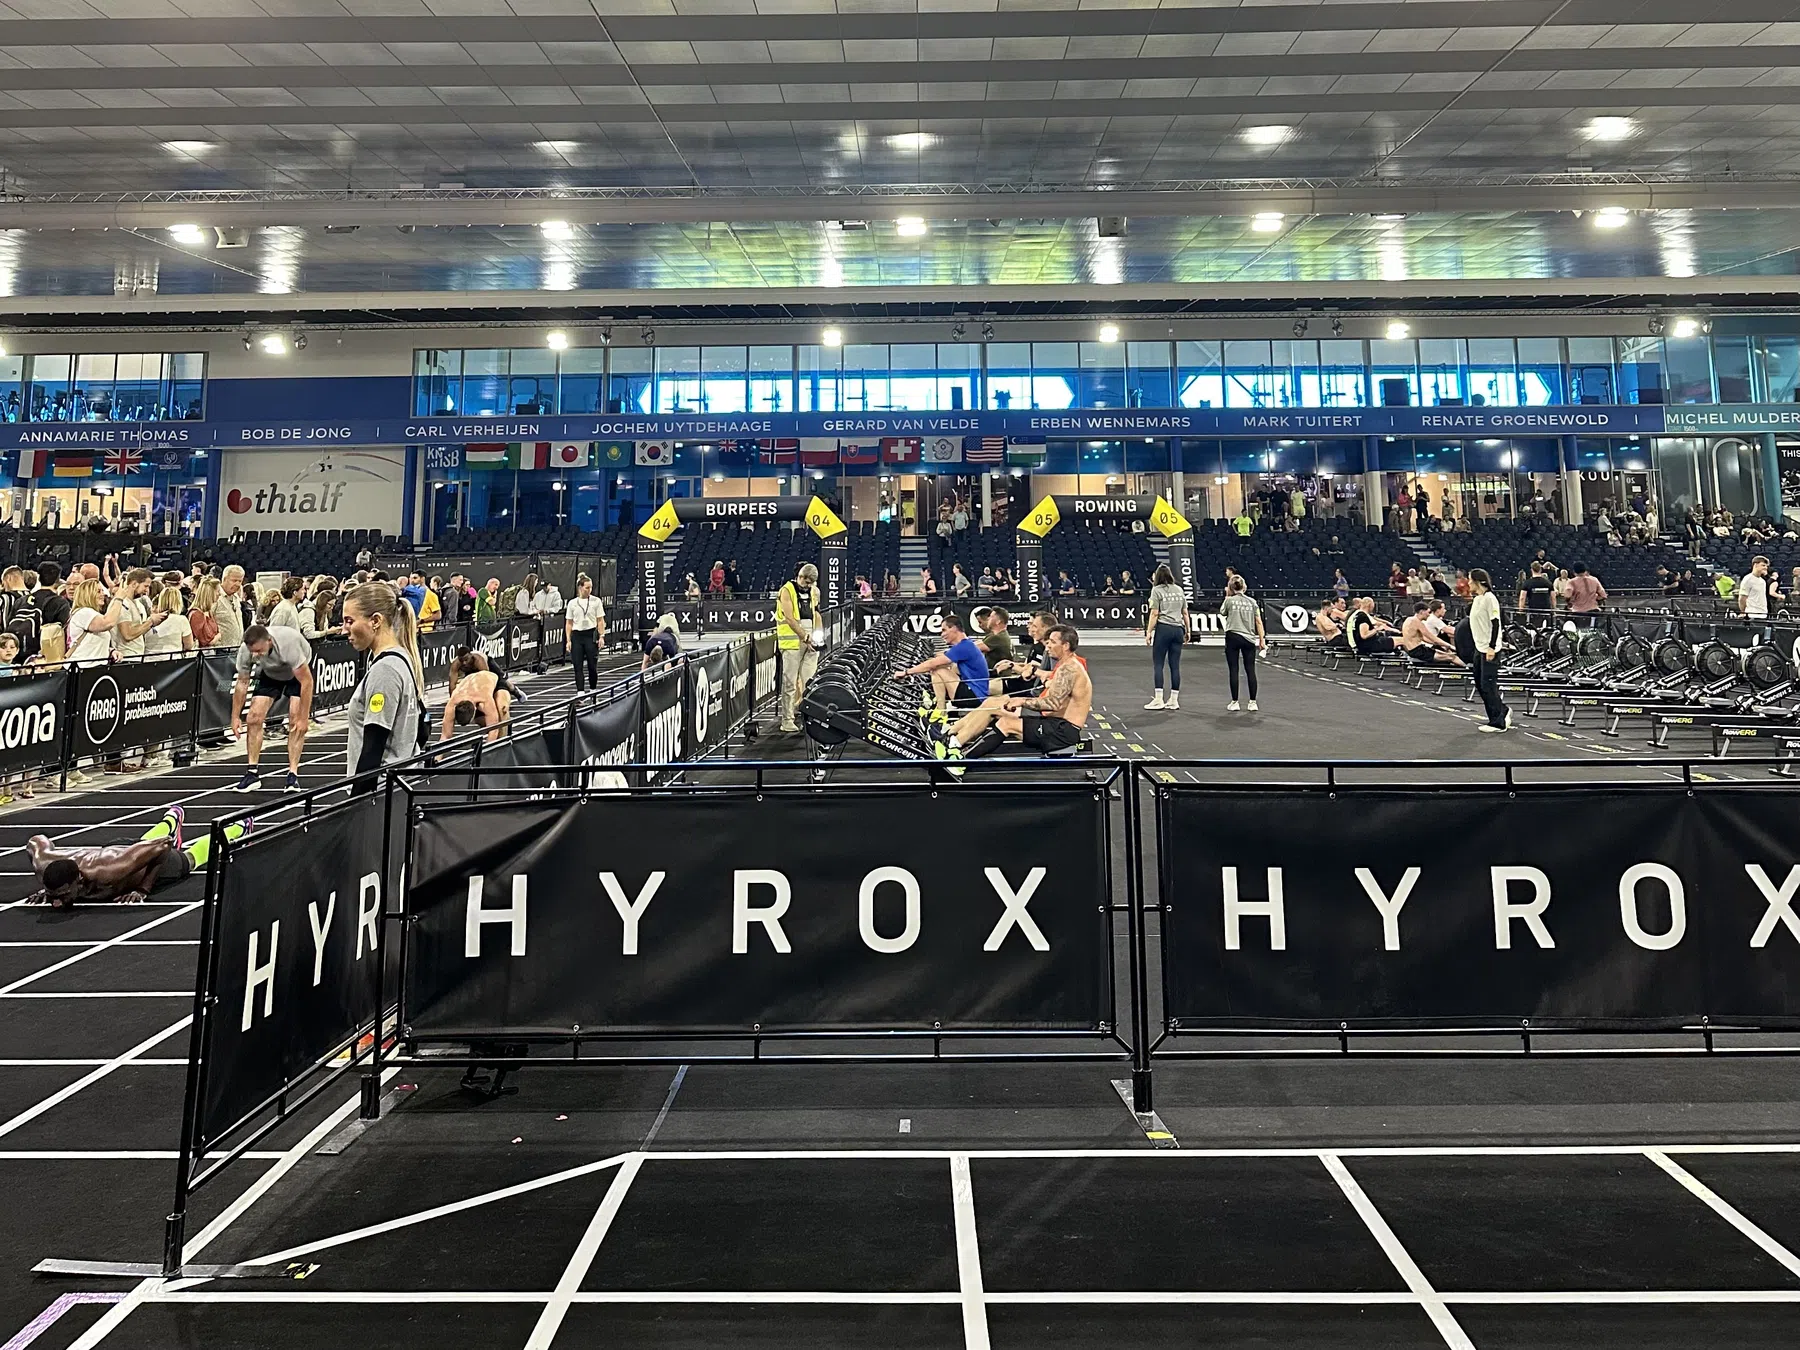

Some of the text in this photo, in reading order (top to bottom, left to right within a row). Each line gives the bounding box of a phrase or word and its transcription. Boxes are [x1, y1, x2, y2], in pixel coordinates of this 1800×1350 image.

[823, 418, 980, 431] GERARD VAN VELDE
[1030, 416, 1192, 429] ERBEN WENNEMARS
[1243, 415, 1363, 427] MARK TUITERT
[1421, 414, 1610, 426] RENATE GROENEWOLD
[1666, 412, 1800, 424] MICHEL MULDER
[241, 427, 352, 440] BOB DE JONG
[405, 424, 540, 437] CARL VERHEIJEN
[592, 421, 772, 434] JOCHEM UYTDEHAAGE
[18, 430, 189, 443] ANNAMARIE THOMAS
[254, 482, 348, 514] thialf
[706, 502, 778, 516] BURPEES
[1075, 499, 1137, 513] ROWING
[652, 518, 671, 530] 04
[812, 514, 831, 527] 04
[1035, 514, 1053, 526] 05
[1159, 512, 1178, 524] 05
[829, 557, 839, 608] URPEES
[1028, 560, 1039, 603] OWING
[1180, 558, 1194, 608] ROWIN
[644, 560, 657, 620] BURPEES
[709, 611, 777, 623] HYROX
[1064, 607, 1136, 619] HYROX
[423, 643, 463, 668] HYRO
[315, 658, 355, 694] Rexona
[124, 687, 157, 708] juridisch
[90, 698, 116, 721] ARAG
[880, 739, 919, 760] concept
[465, 865, 1051, 958] HYROX
[1221, 862, 1800, 951] HYROX
[241, 866, 392, 1033] HYR
